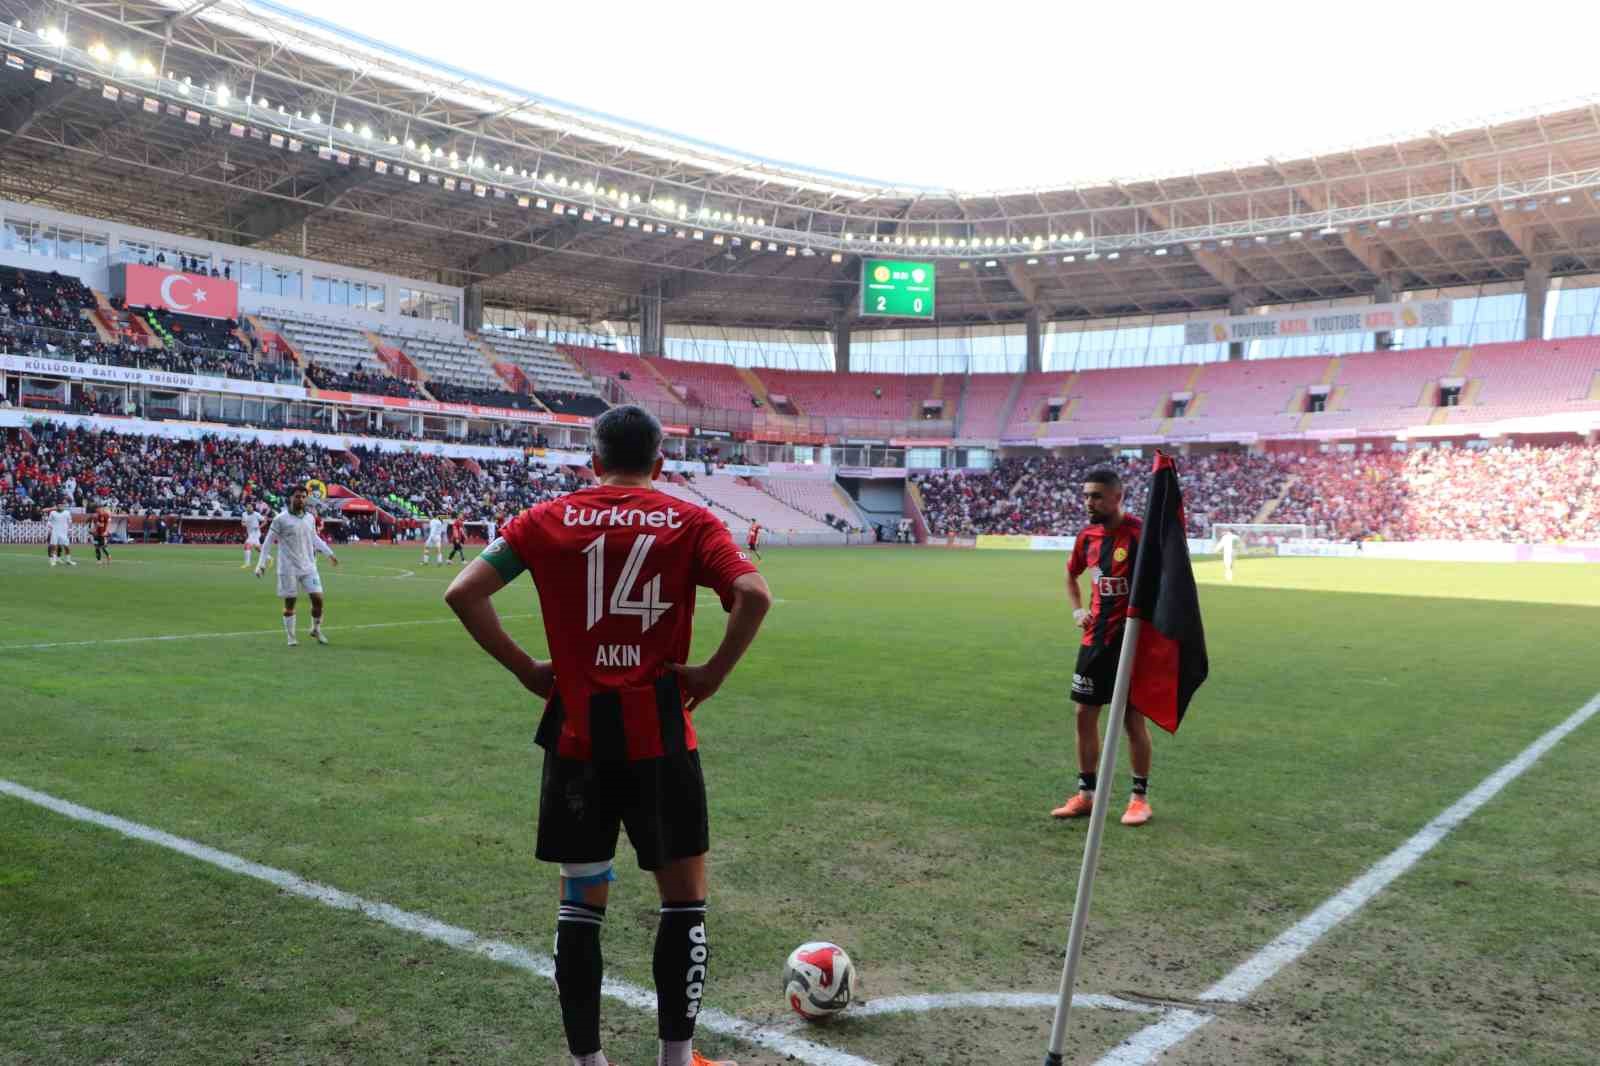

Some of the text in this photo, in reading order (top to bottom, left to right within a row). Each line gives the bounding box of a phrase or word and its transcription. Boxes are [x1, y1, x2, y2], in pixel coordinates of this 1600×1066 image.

[877, 296, 923, 313] 2 0
[1231, 320, 1277, 338] YOUTUBE
[1313, 313, 1361, 332] YOUTUBE
[563, 505, 683, 528] turknet
[581, 532, 674, 633] 14
[595, 645, 641, 666] AKIN
